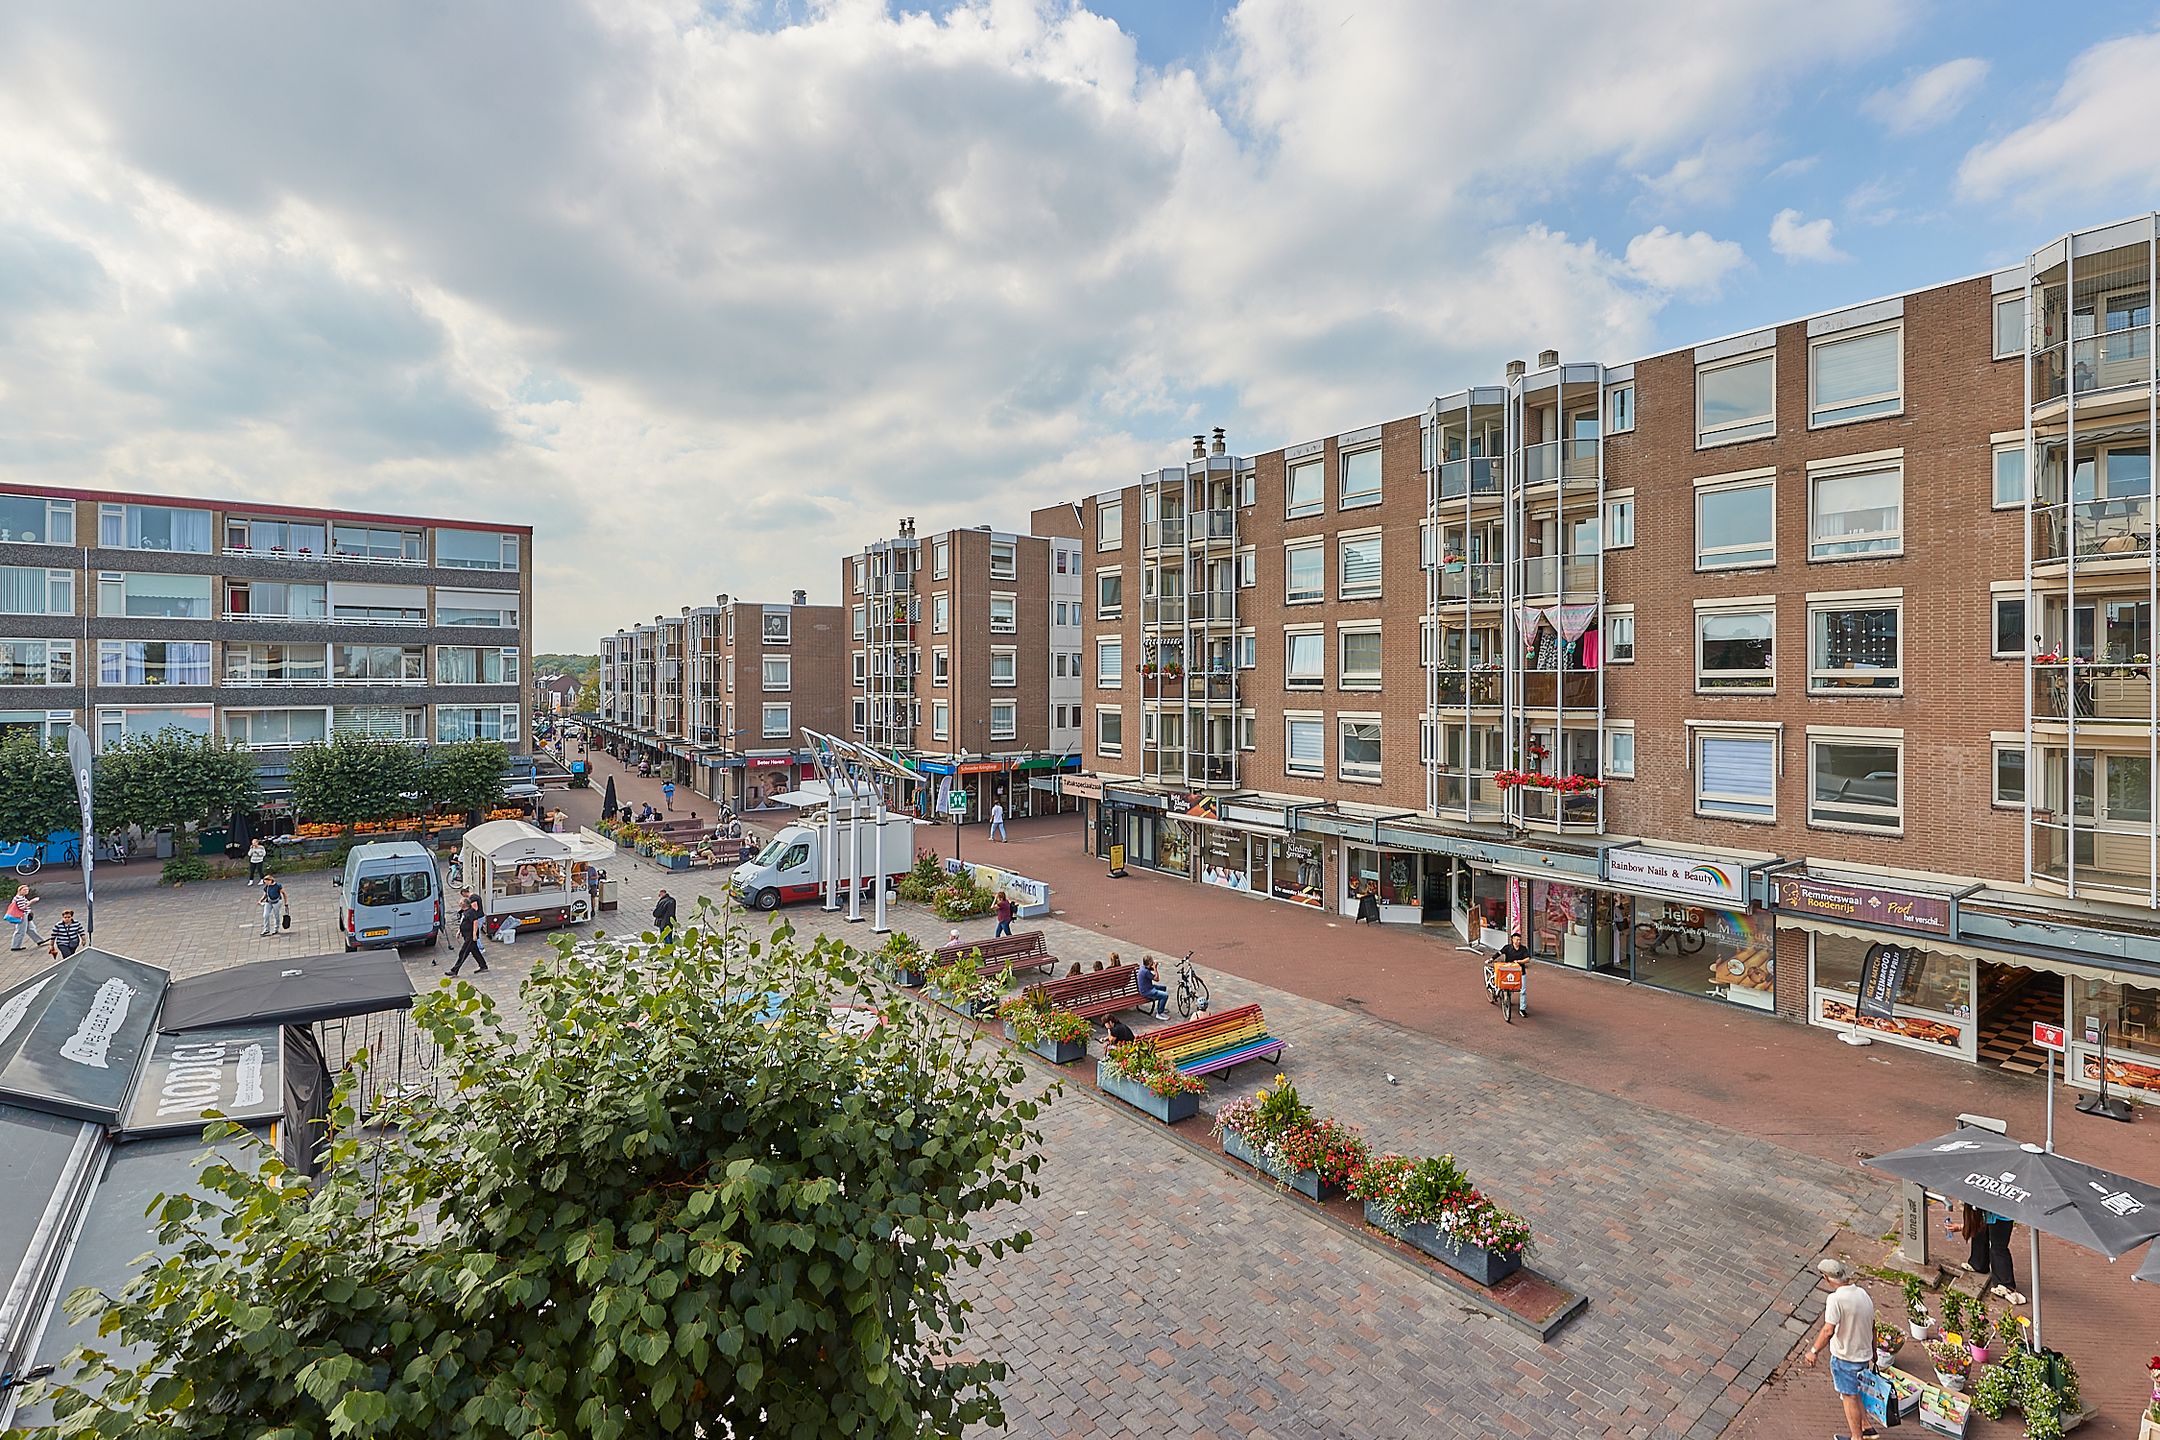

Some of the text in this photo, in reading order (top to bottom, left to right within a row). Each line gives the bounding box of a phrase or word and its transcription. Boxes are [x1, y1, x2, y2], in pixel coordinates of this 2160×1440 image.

[1285, 850, 1305, 859] Service
[1287, 844, 1312, 857] Kleding
[1611, 860, 1645, 873] Rainbow
[1647, 865, 1668, 877] Nails
[1672, 869, 1679, 878] &
[1684, 870, 1713, 886] Beauty
[1801, 888, 1863, 906] Remmerswaal
[1807, 897, 1855, 913] Roodenrijs
[1662, 906, 1700, 924] Hello
[1887, 902, 1913, 914] Proef
[1903, 913, 1914, 922] het
[1890, 952, 1900, 970] PRIJS
[1874, 951, 1891, 1002] KLEINBROOD
[1887, 969, 1897, 988] HALVE
[155, 1041, 227, 1117] NODIG!
[1963, 1172, 2032, 1204] CORNET
[1907, 1213, 1918, 1241] dunea
